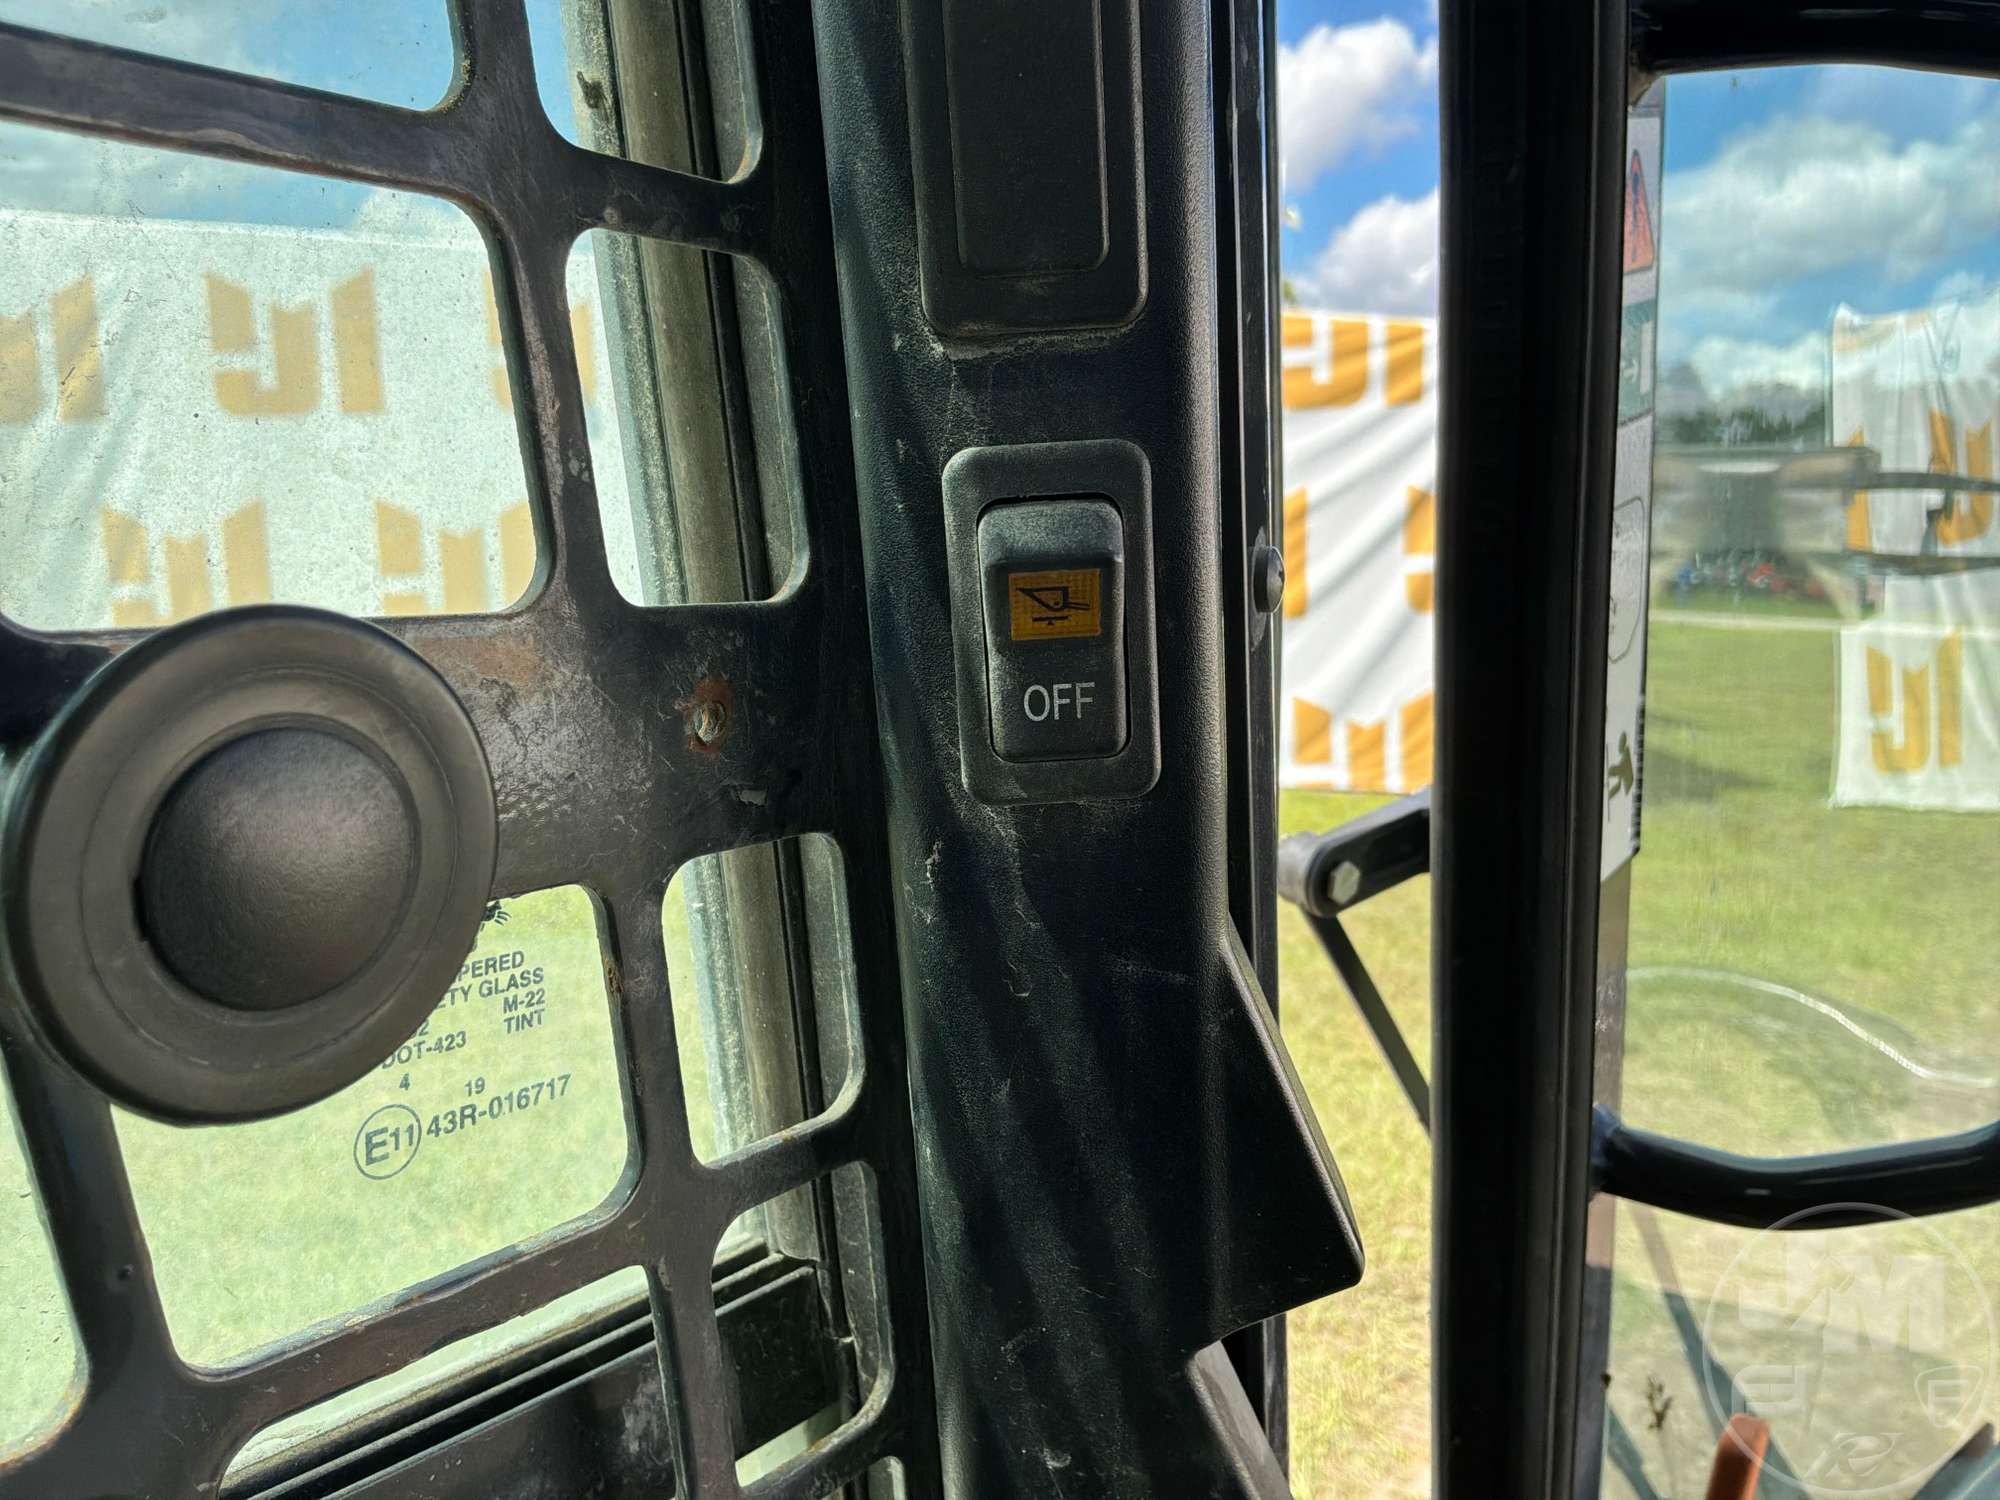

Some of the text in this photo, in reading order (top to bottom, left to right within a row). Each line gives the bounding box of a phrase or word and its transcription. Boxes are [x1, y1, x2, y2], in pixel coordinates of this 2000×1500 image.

[1024, 682, 1095, 721] OFF
[479, 967, 544, 998] GLASS
[503, 988, 545, 1013] M-22
[504, 1008, 545, 1034] TINT
[399, 1073, 411, 1090] 4
[464, 1077, 486, 1096] 19
[426, 1074, 571, 1138] 43R-016717
